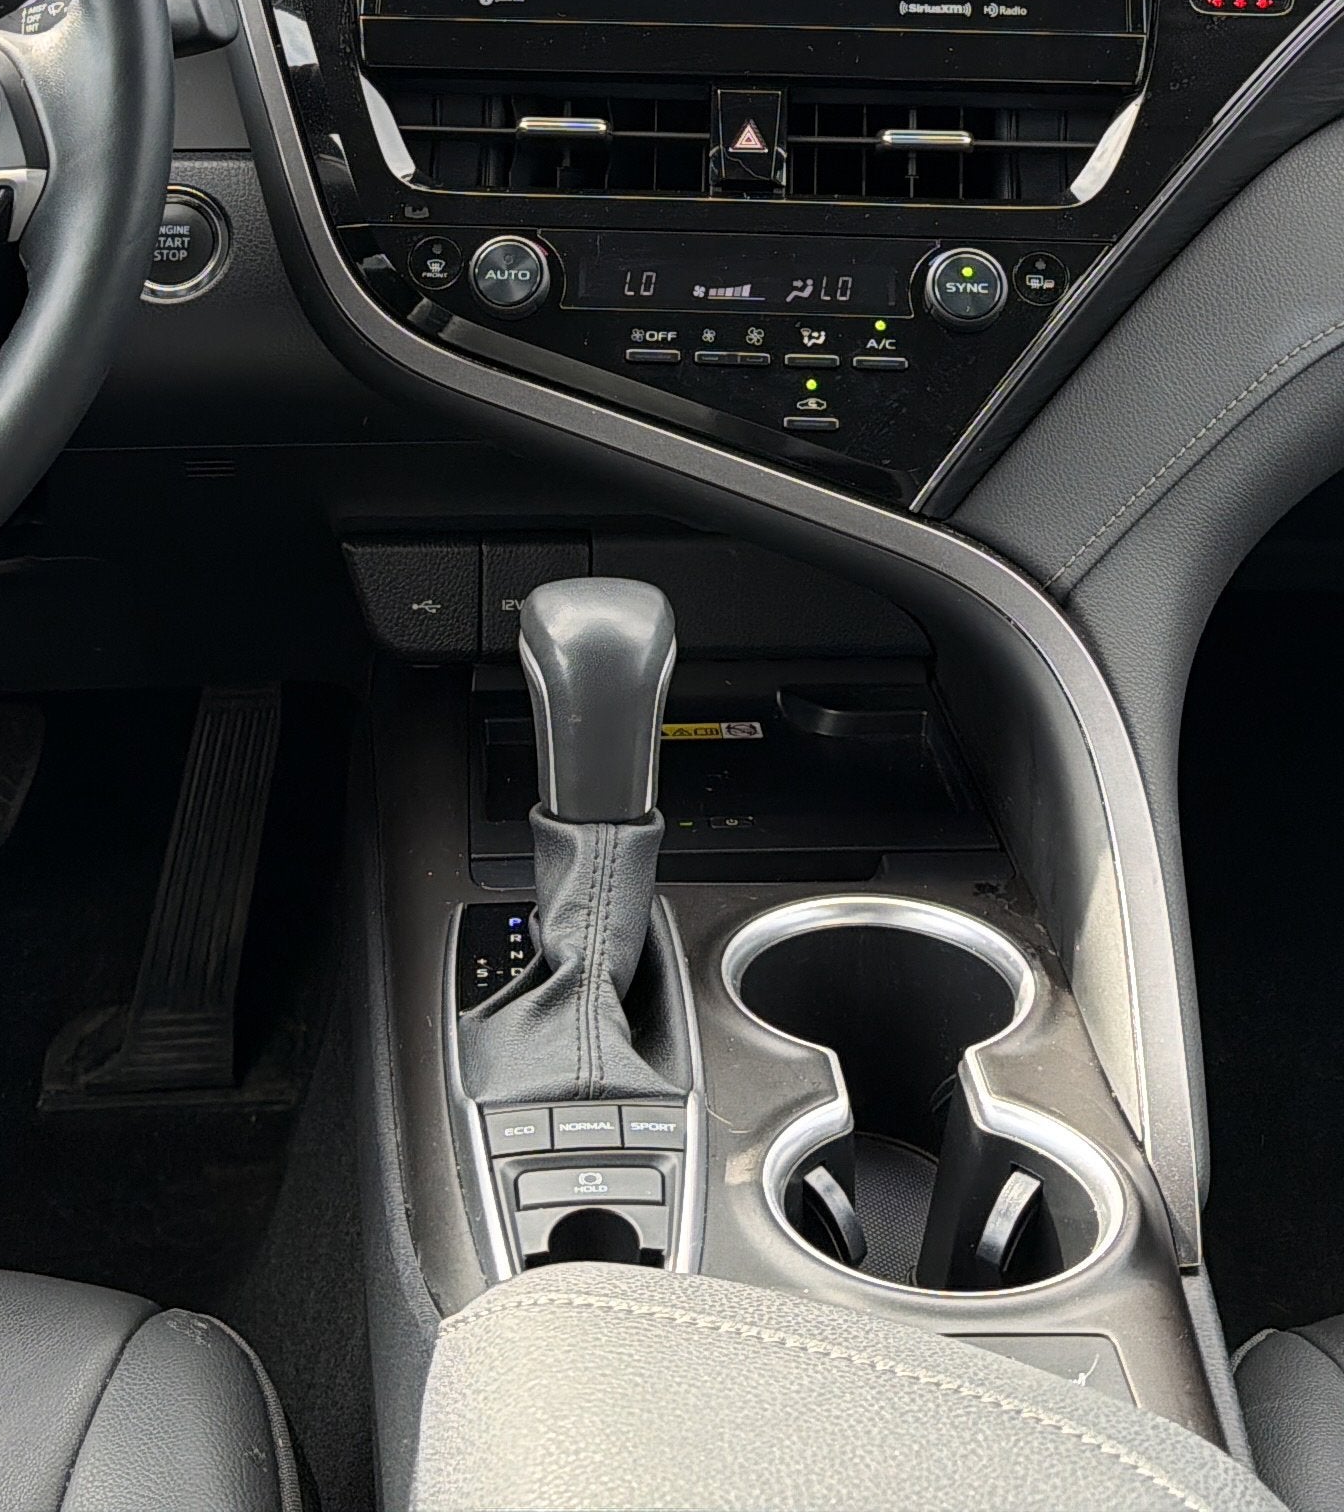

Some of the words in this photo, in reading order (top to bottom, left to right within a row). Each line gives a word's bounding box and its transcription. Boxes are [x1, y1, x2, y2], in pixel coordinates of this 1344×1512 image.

[27, 3, 47, 15] MIST
[999, 5, 1028, 16] Radio
[26, 14, 41, 24] OFF
[25, 23, 39, 33] INT
[158, 225, 191, 235] NGINE
[156, 237, 191, 248] TART
[153, 249, 188, 261] STOP
[421, 271, 450, 279] FRONT
[484, 269, 531, 281] AUTO
[945, 282, 989, 294] SYNC
[645, 330, 678, 342] OFF
[866, 339, 896, 350] A/C
[501, 599, 525, 611] 12V
[508, 917, 523, 927] P
[510, 933, 523, 943] R
[510, 950, 524, 960] N
[476, 968, 489, 978] S
[504, 1125, 535, 1137] ECO
[558, 1121, 615, 1132] NORMAL
[630, 1121, 677, 1132] SPORT
[573, 1184, 608, 1194] HOLD
